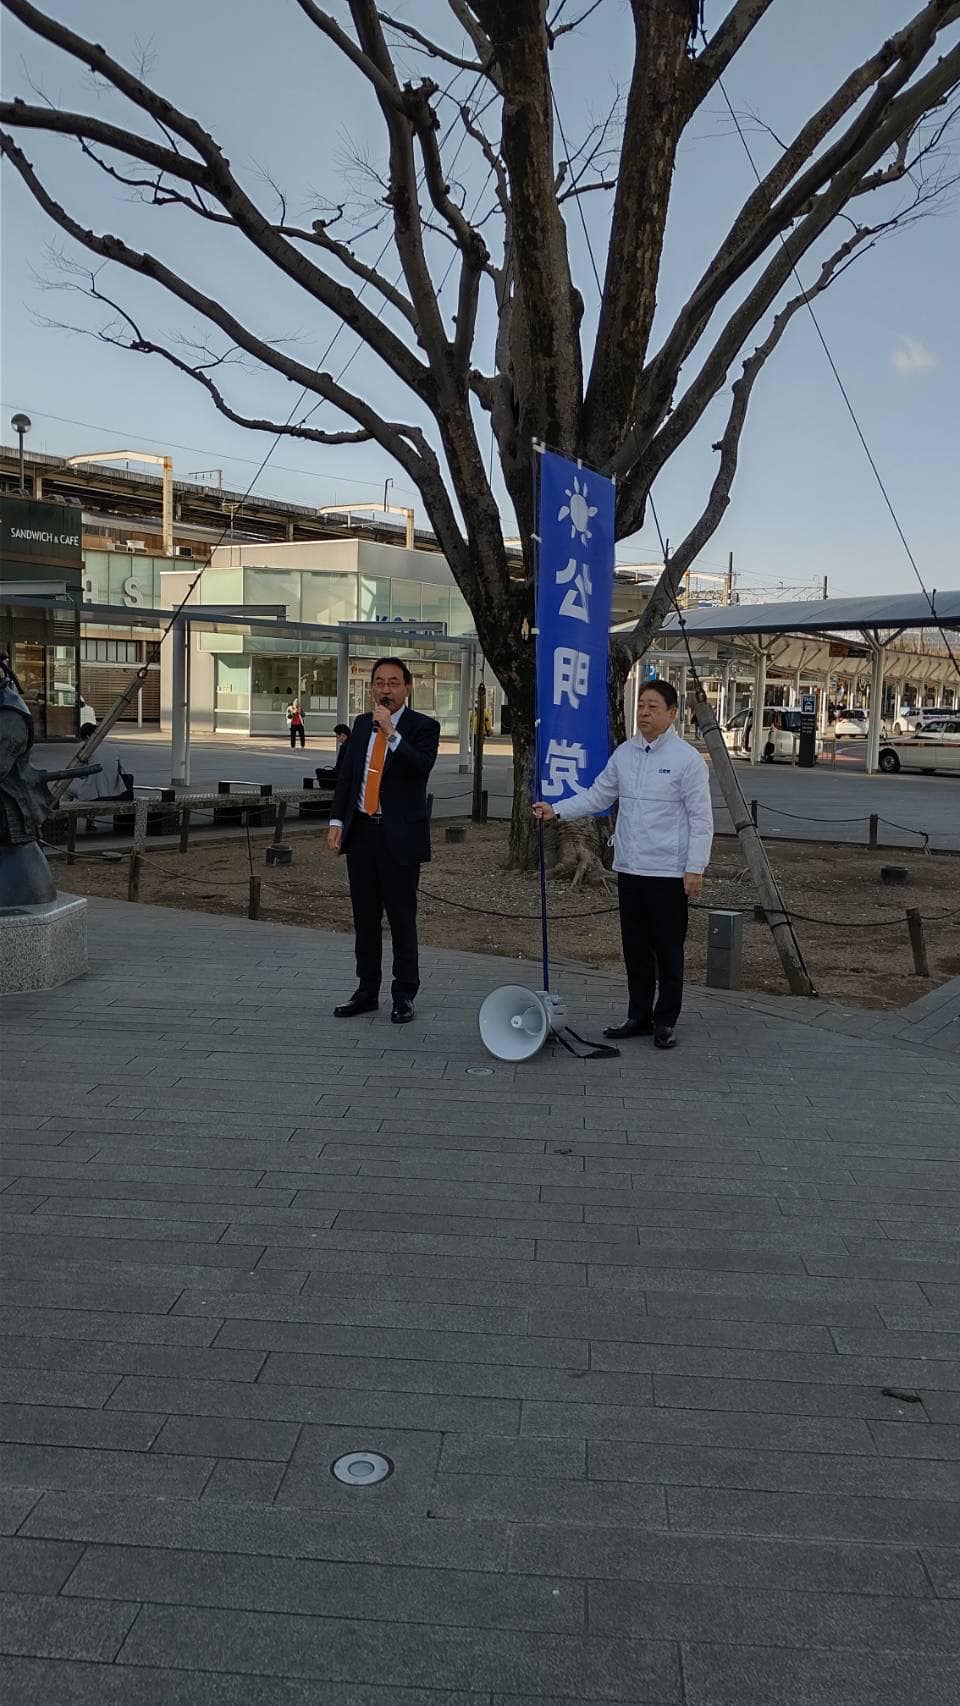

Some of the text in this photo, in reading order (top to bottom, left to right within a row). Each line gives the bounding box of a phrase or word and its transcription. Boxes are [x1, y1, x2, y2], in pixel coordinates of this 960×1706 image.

[10, 527, 80, 546] SANDWICH & CAFE
